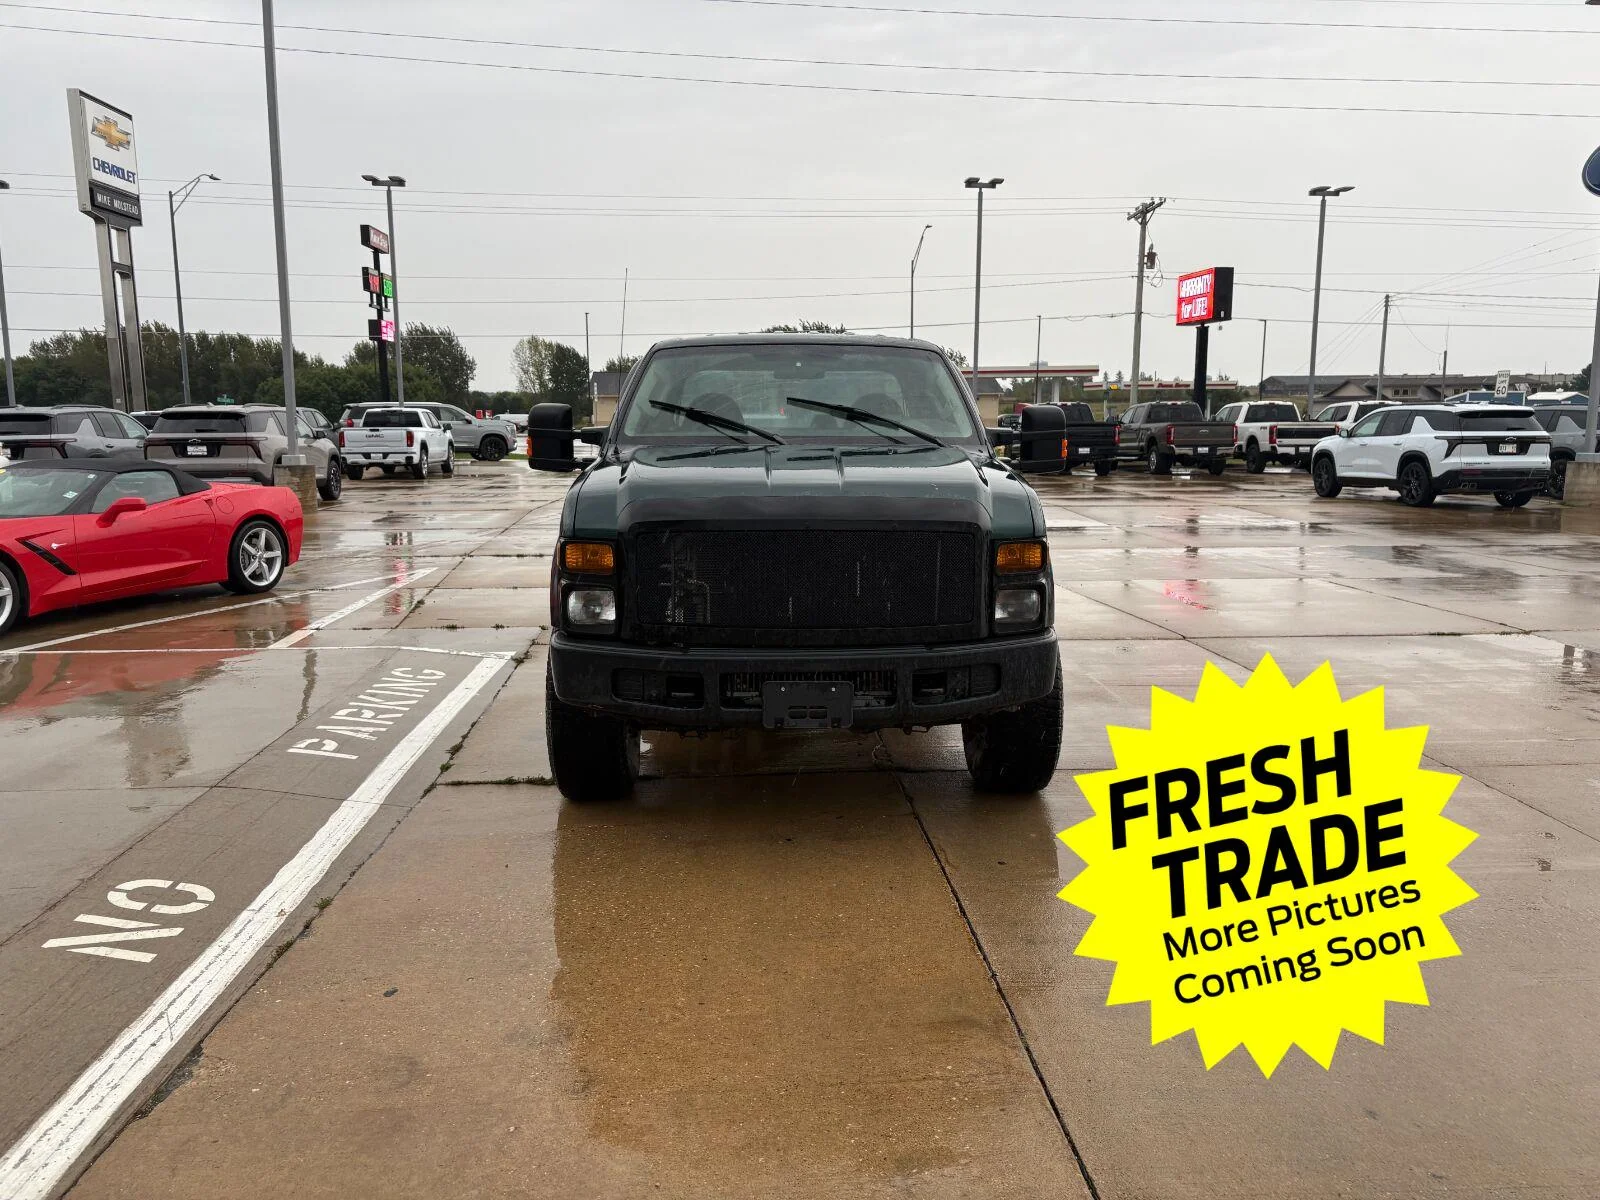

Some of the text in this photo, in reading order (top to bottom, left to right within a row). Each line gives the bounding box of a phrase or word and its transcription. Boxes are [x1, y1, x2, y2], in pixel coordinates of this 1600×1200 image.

[92, 157, 136, 185] CHEVROLET
[97, 192, 139, 215] MIKE MOLSTEAD
[1496, 385, 1507, 395] 60
[41, 667, 446, 963] NO PARKING
